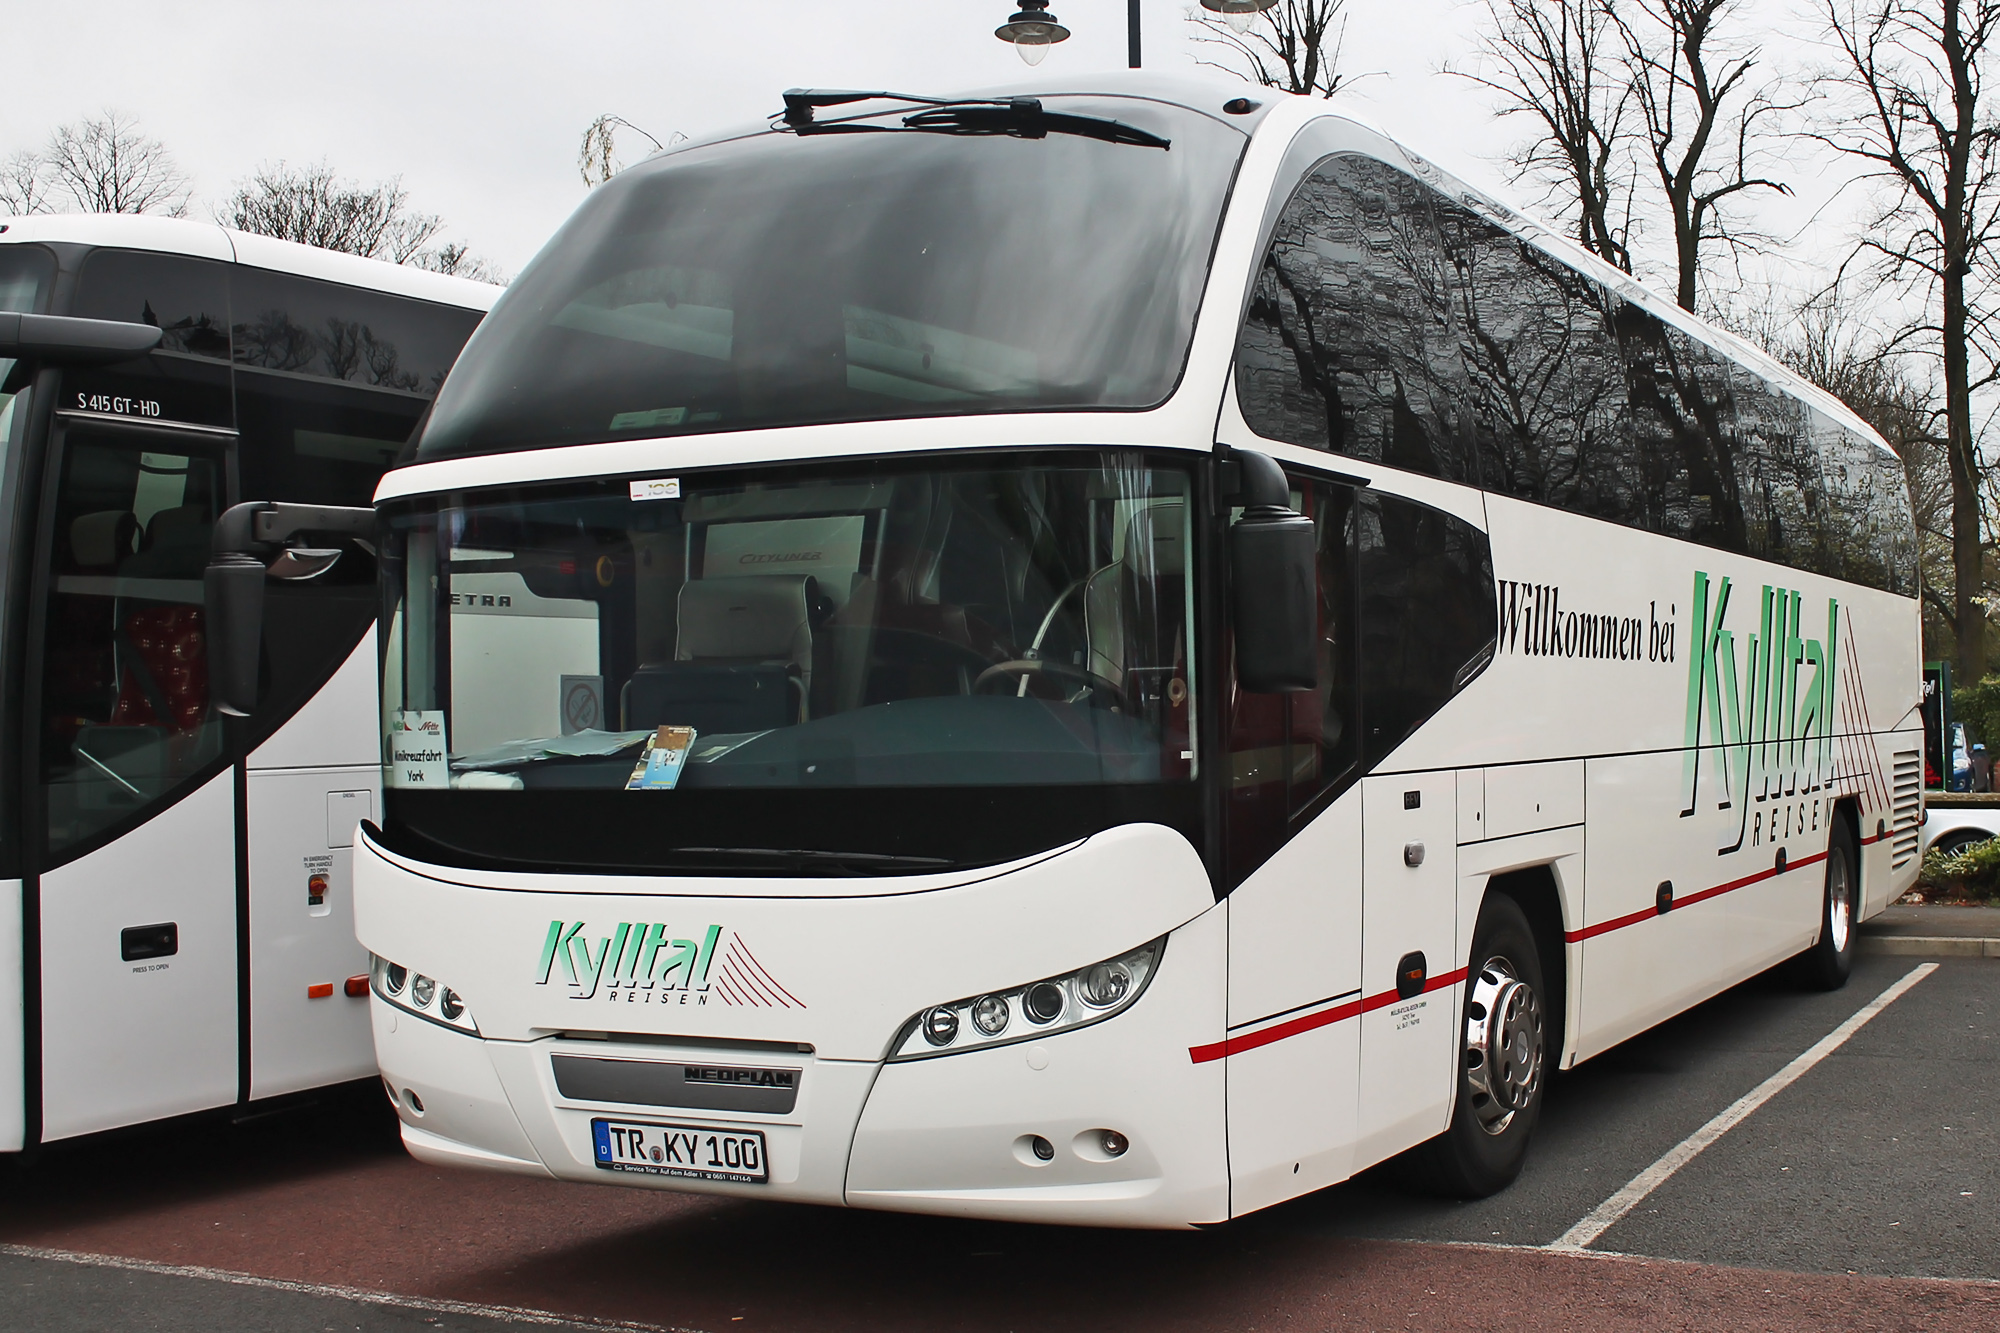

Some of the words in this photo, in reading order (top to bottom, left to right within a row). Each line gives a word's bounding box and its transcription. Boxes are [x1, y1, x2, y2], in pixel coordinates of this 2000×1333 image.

[78, 392, 87, 409] S
[89, 394, 111, 412] 415
[451, 593, 511, 607] ETRA
[1498, 580, 1642, 661] Willkommen
[1649, 600, 1675, 663] bei
[1679, 571, 1839, 857] Kylltal
[407, 770, 424, 781] York
[1405, 792, 1419, 806] EEV
[1752, 797, 1833, 848] REISEN
[535, 920, 723, 1000] Kylltal
[609, 991, 708, 1006] REISEN
[684, 1066, 793, 1087] NEOPLAN
[601, 1145, 608, 1154] D
[610, 1127, 647, 1160] TR
[664, 1132, 698, 1165] KY
[706, 1136, 759, 1170] 100
[624, 1164, 644, 1173] Service
